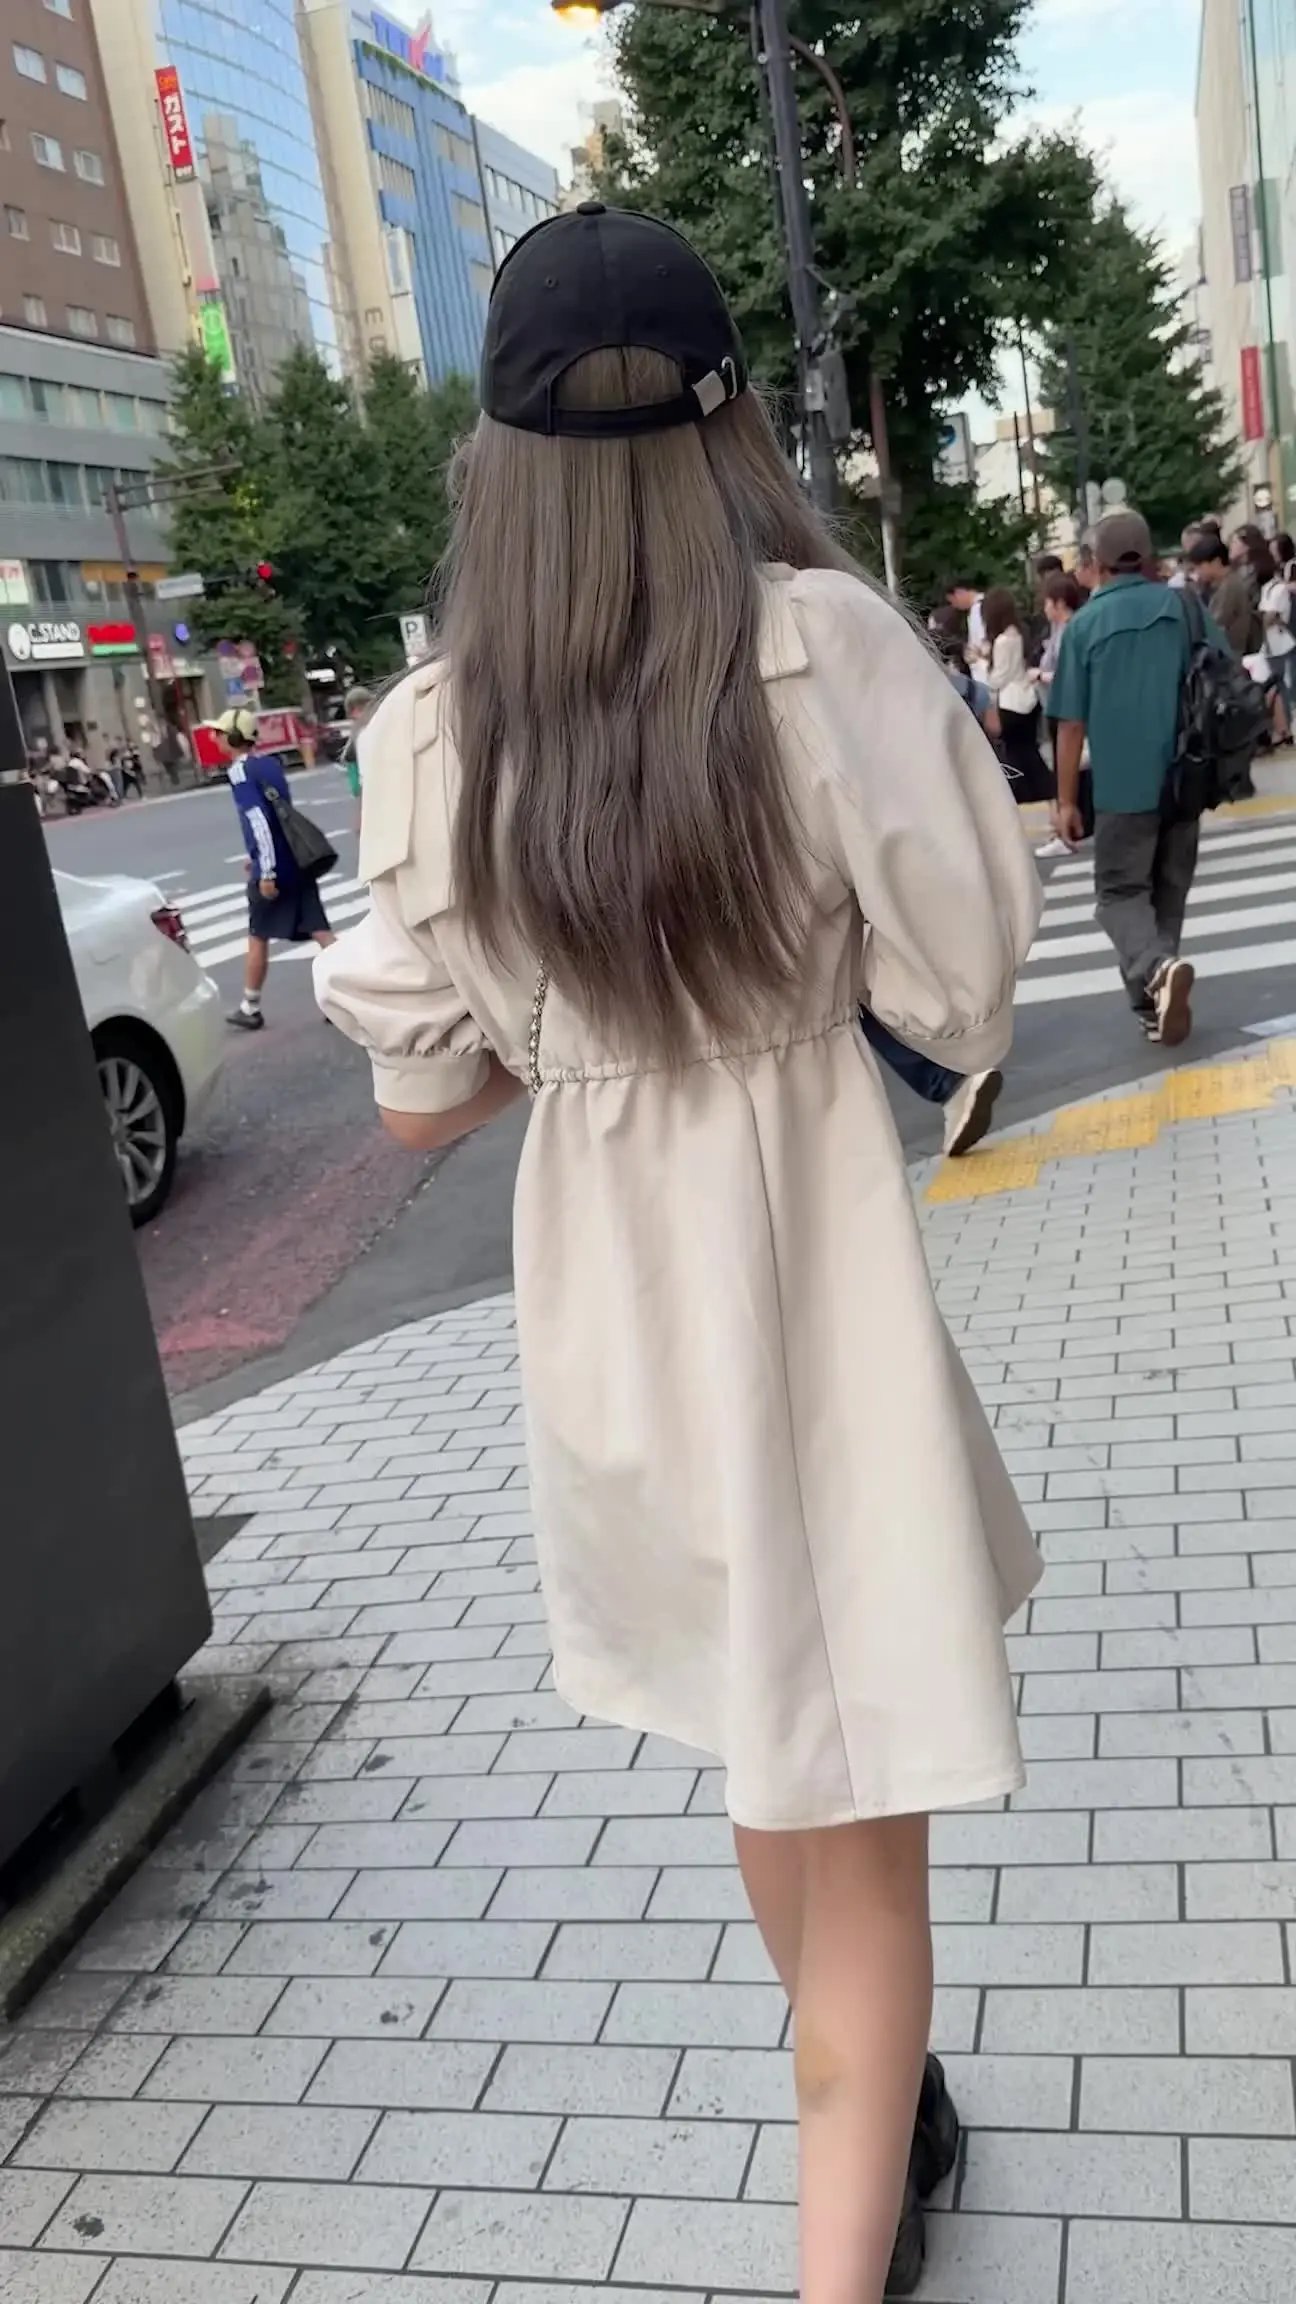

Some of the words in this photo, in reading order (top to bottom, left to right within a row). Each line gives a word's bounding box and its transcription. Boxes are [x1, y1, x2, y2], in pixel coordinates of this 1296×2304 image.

[164, 92, 187, 156] ガスト
[405, 620, 418, 640] P
